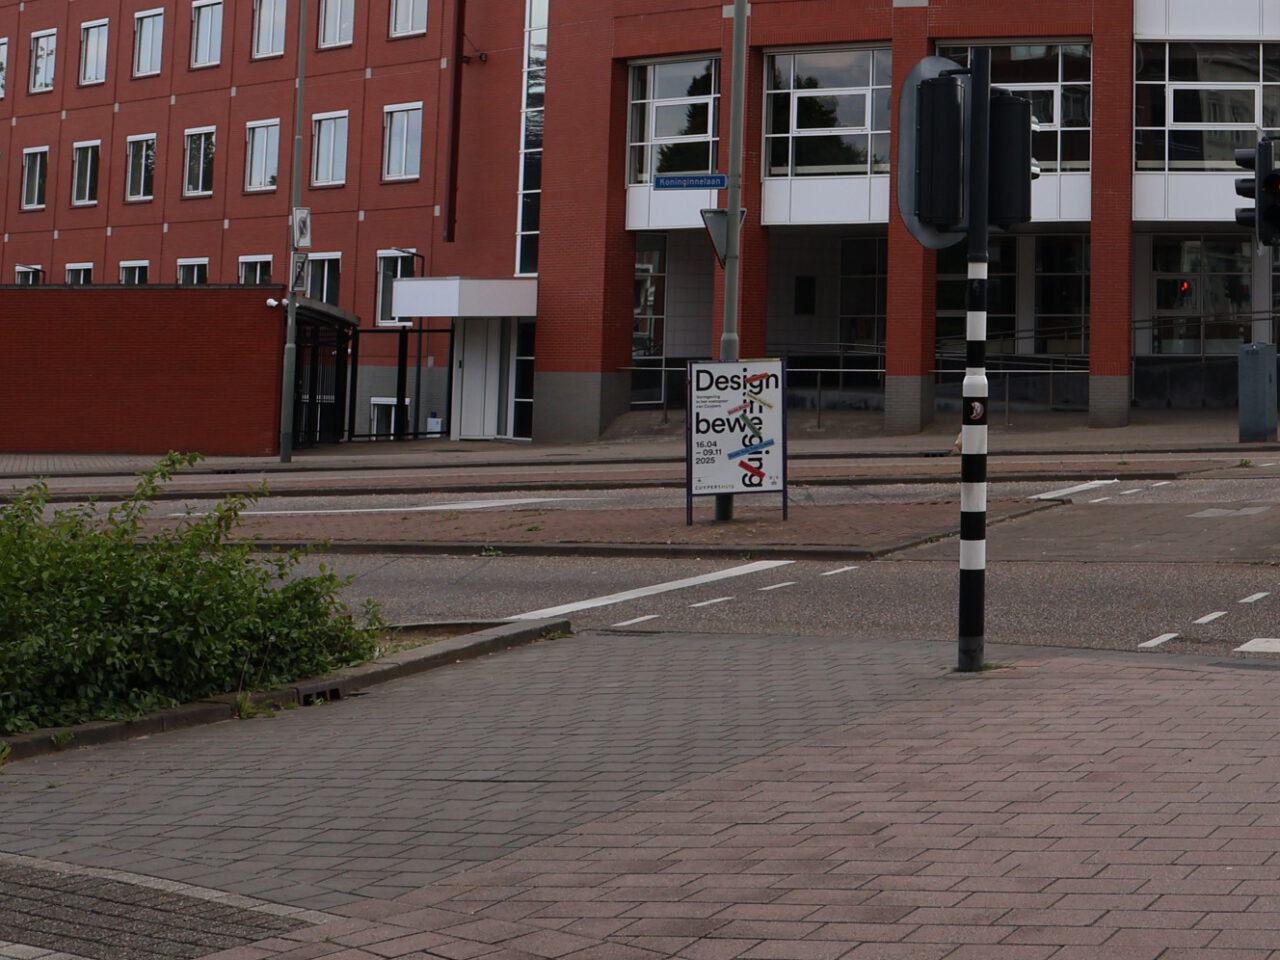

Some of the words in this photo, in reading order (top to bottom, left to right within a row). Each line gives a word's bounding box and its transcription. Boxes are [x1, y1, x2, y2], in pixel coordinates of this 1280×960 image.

[660, 178, 720, 187] Koninginnelaan
[696, 368, 779, 395] Design
[696, 441, 717, 449] 16.04
